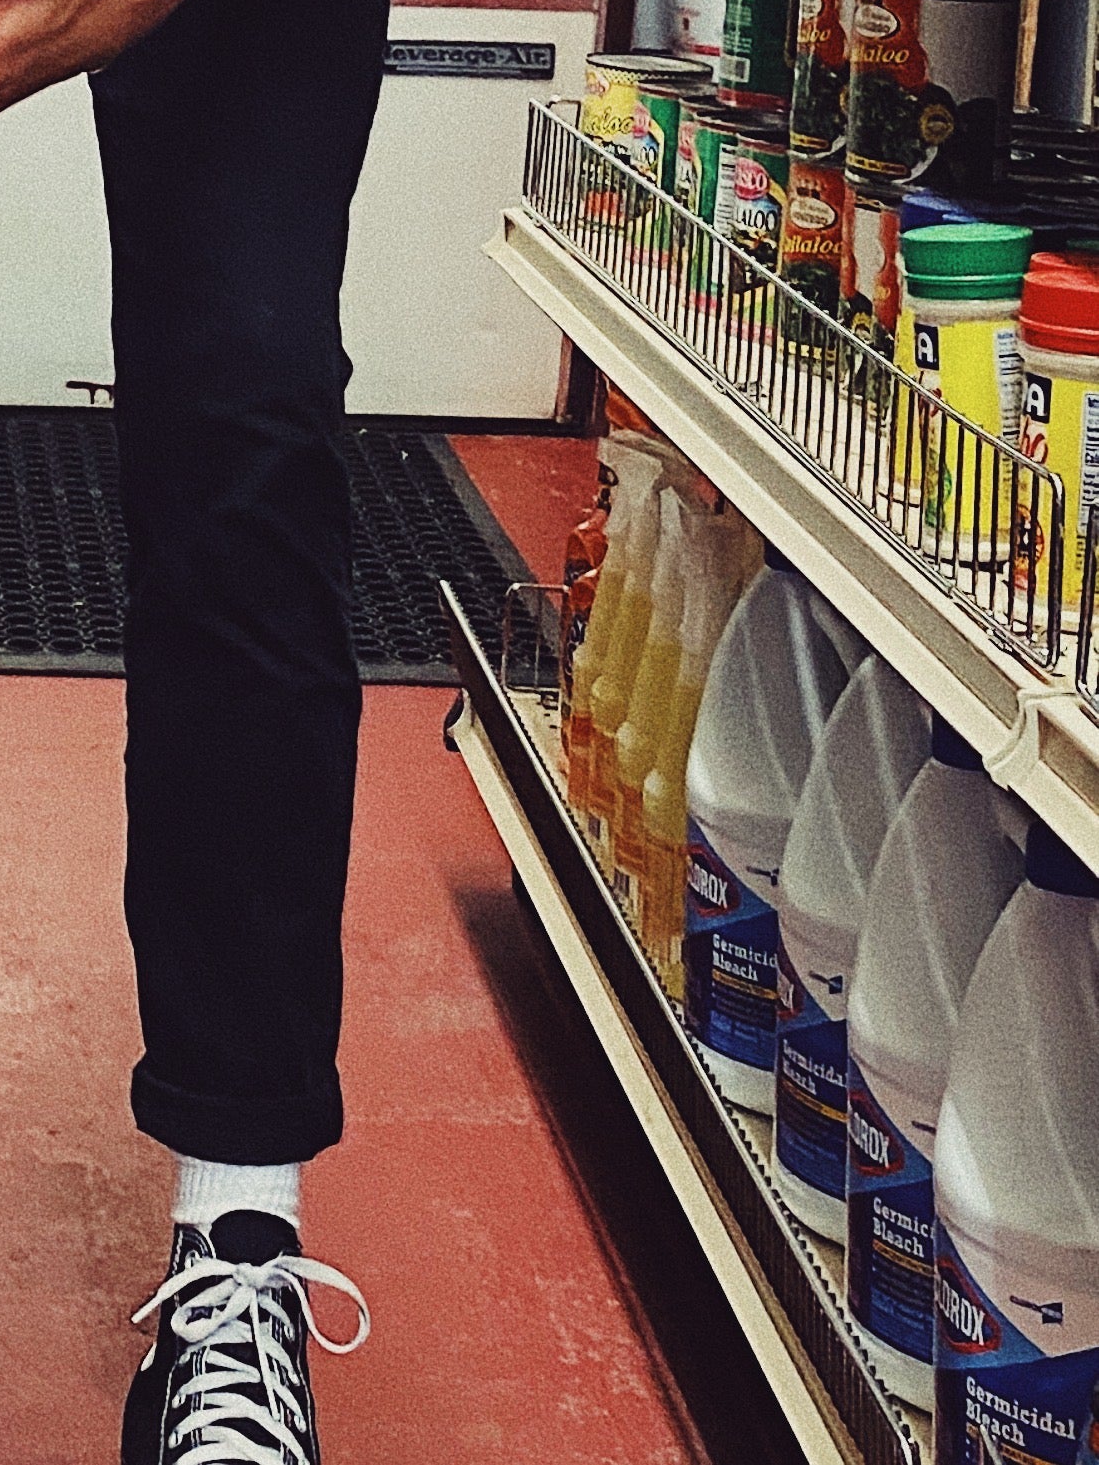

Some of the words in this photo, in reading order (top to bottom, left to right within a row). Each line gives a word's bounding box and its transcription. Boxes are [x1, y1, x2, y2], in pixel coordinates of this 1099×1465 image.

[712, 952, 759, 983] Bleach
[873, 1216, 925, 1259] Bleach
[965, 1375, 1076, 1441] Germicidal
[965, 1397, 1026, 1447] Bleach
